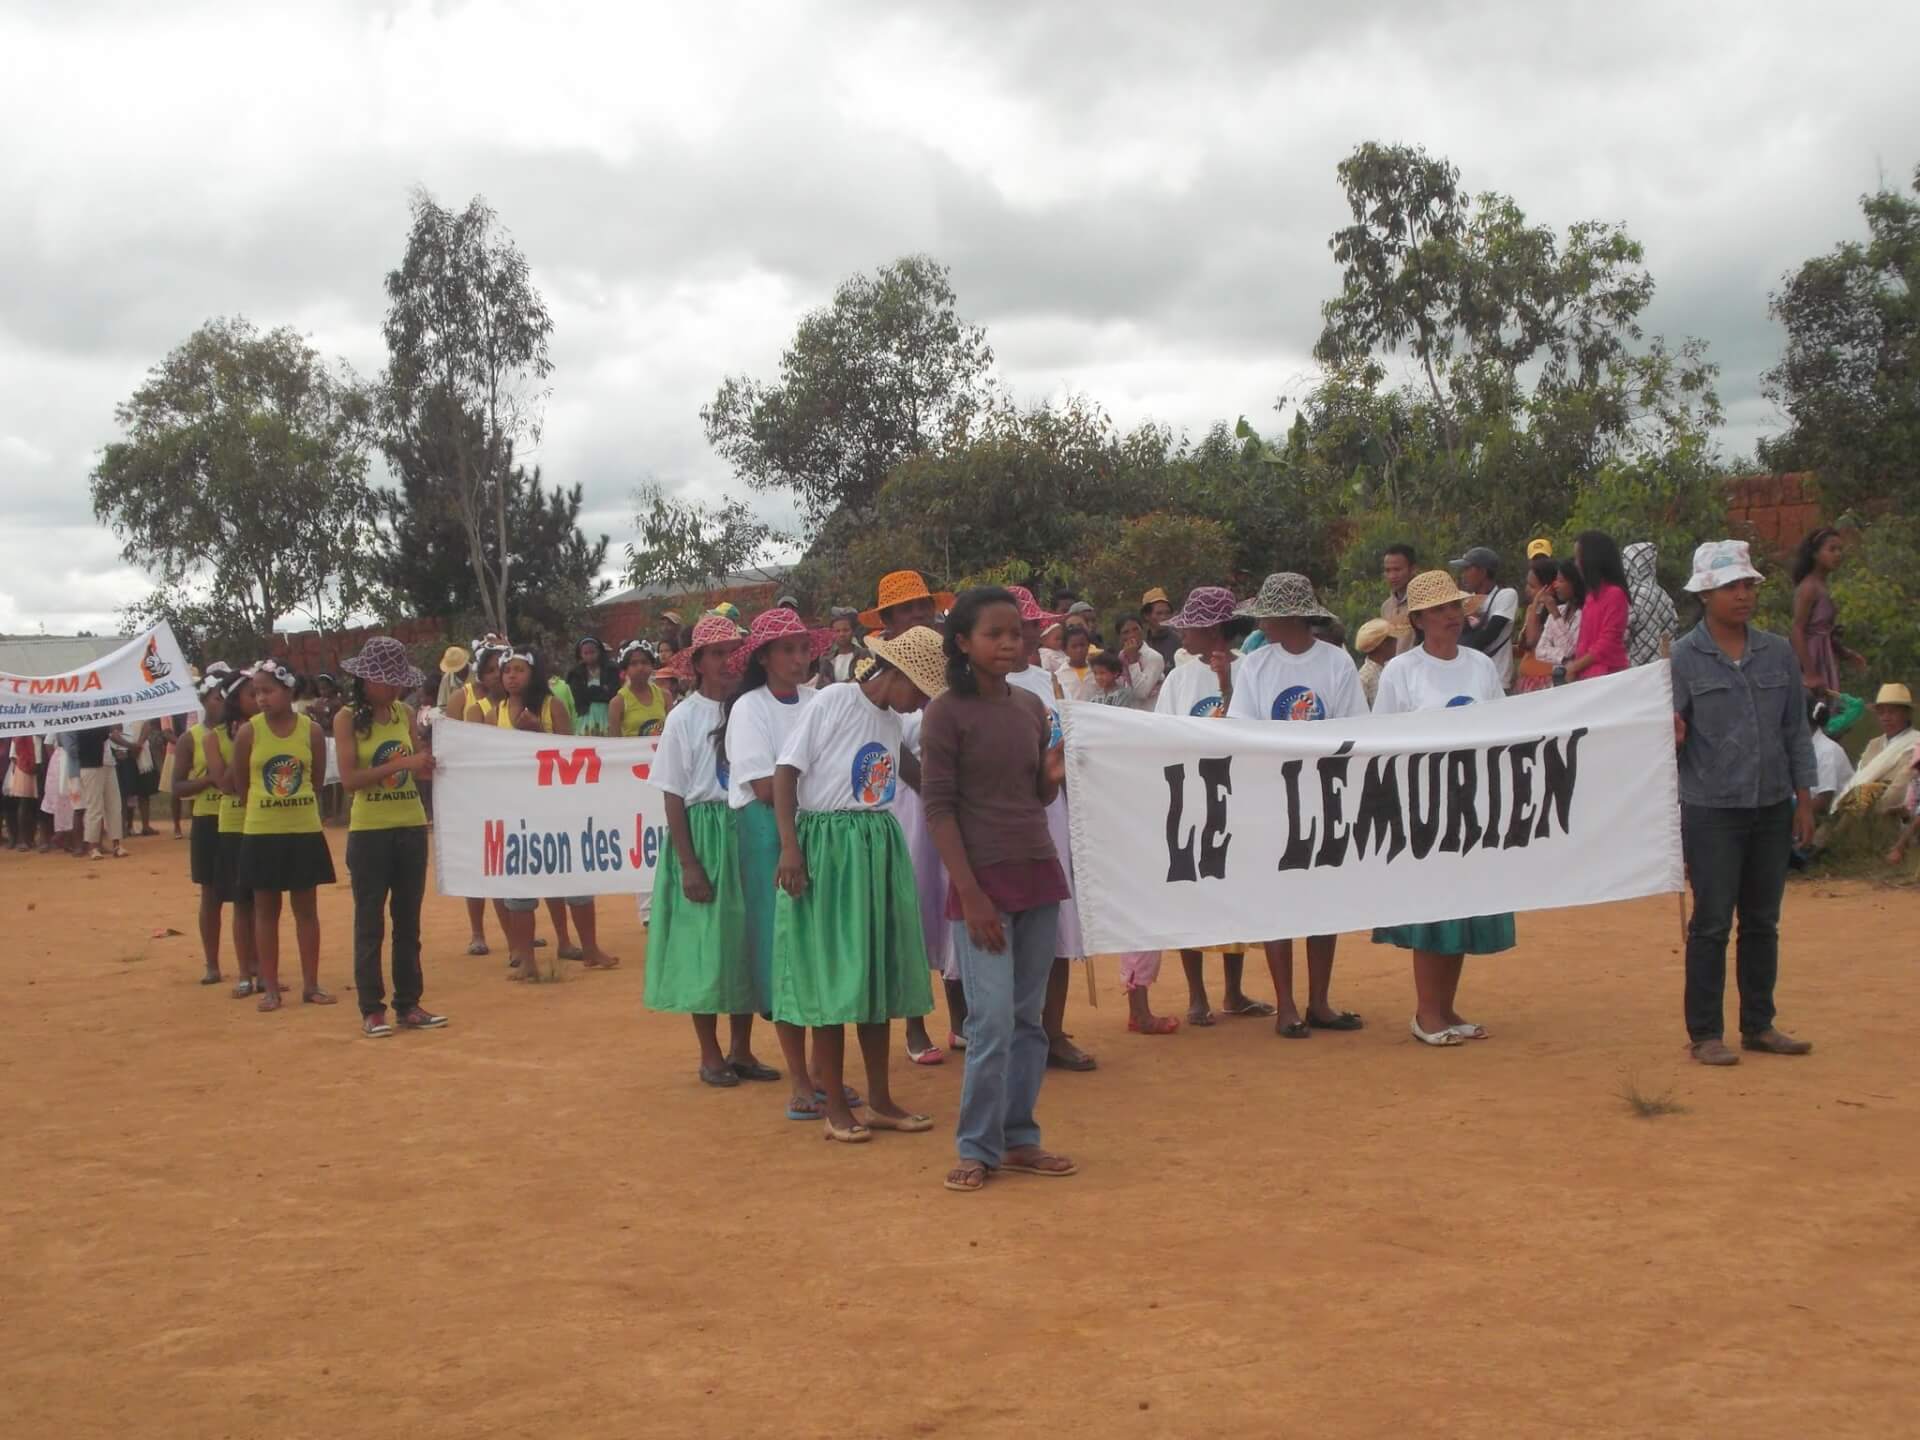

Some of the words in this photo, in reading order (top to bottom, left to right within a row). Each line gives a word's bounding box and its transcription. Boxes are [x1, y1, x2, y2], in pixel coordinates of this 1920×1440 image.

[0, 671, 102, 695] TMMA
[135, 680, 180, 702] AMADEA
[43, 709, 125, 727] MAROVATANA
[536, 747, 602, 786] M
[1163, 755, 1232, 882] LE
[1278, 727, 1588, 871] LÉMURIEN
[484, 818, 572, 877] Maison
[581, 816, 623, 872] des
